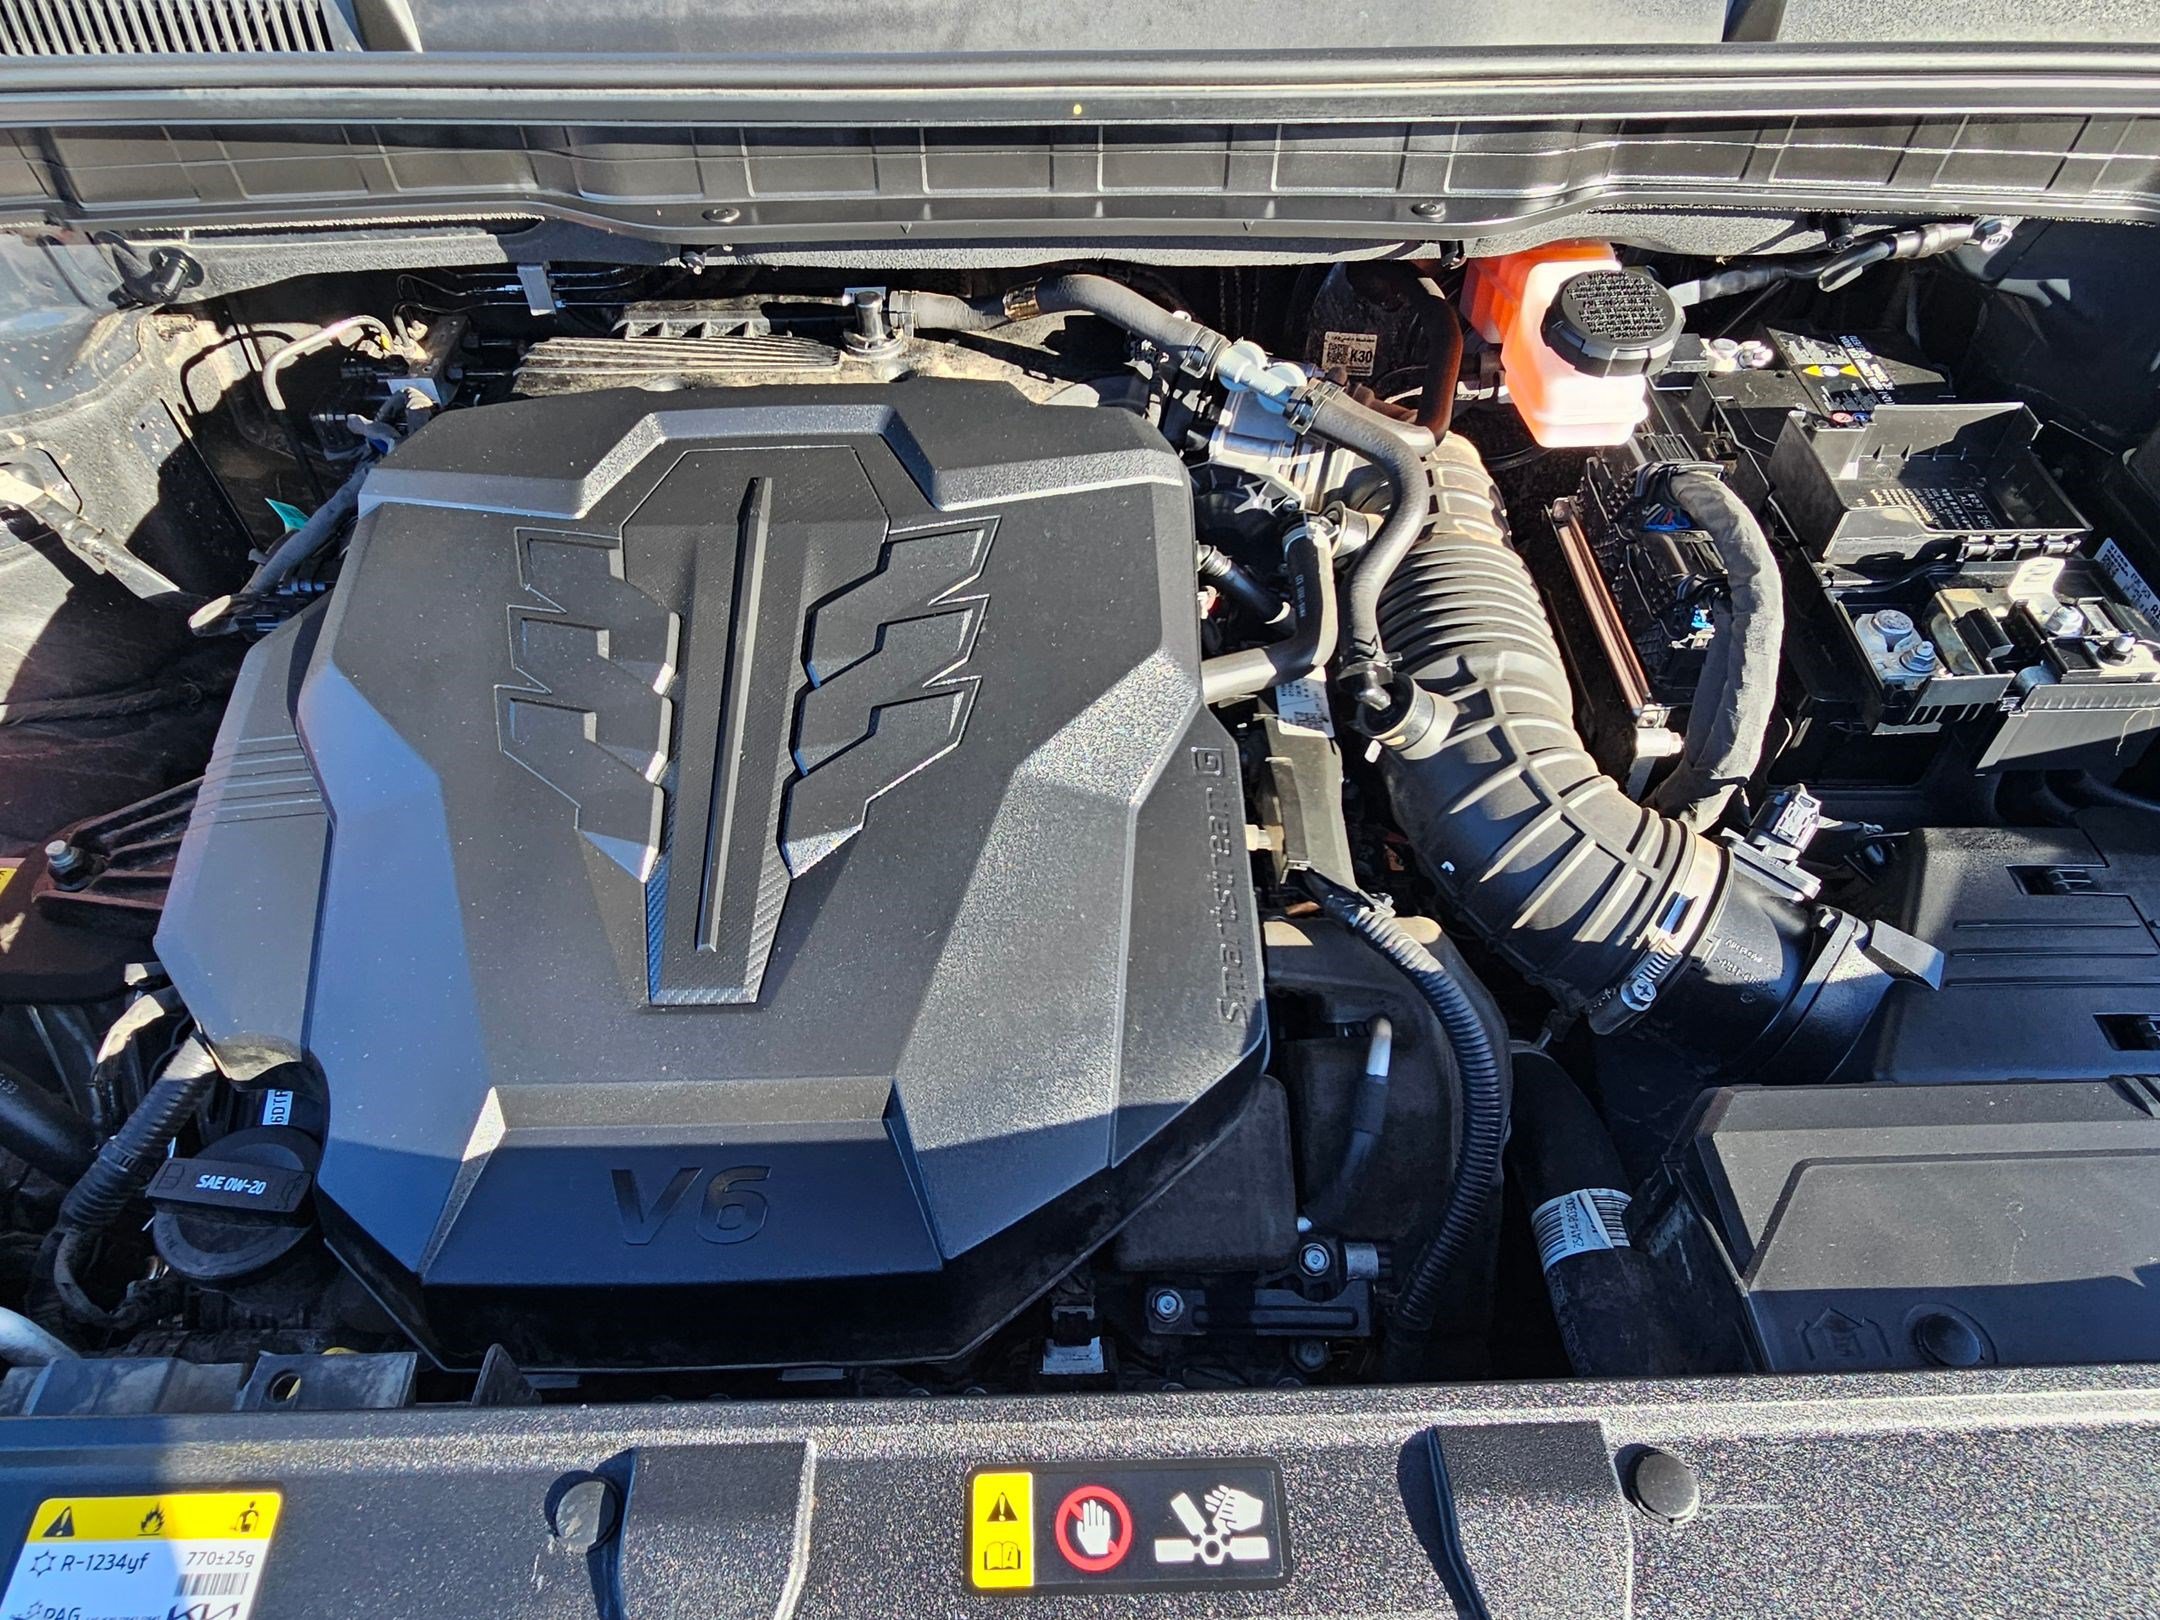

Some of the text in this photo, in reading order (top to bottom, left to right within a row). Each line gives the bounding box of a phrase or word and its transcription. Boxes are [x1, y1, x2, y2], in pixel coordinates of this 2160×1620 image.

[1350, 349, 1373, 363] K30
[1191, 746, 1247, 1024] Smartstream G
[195, 1174, 267, 1195] SAE 0W-20
[610, 1164, 772, 1246] V6
[60, 1550, 255, 1575] R-1234yf 770±25g
